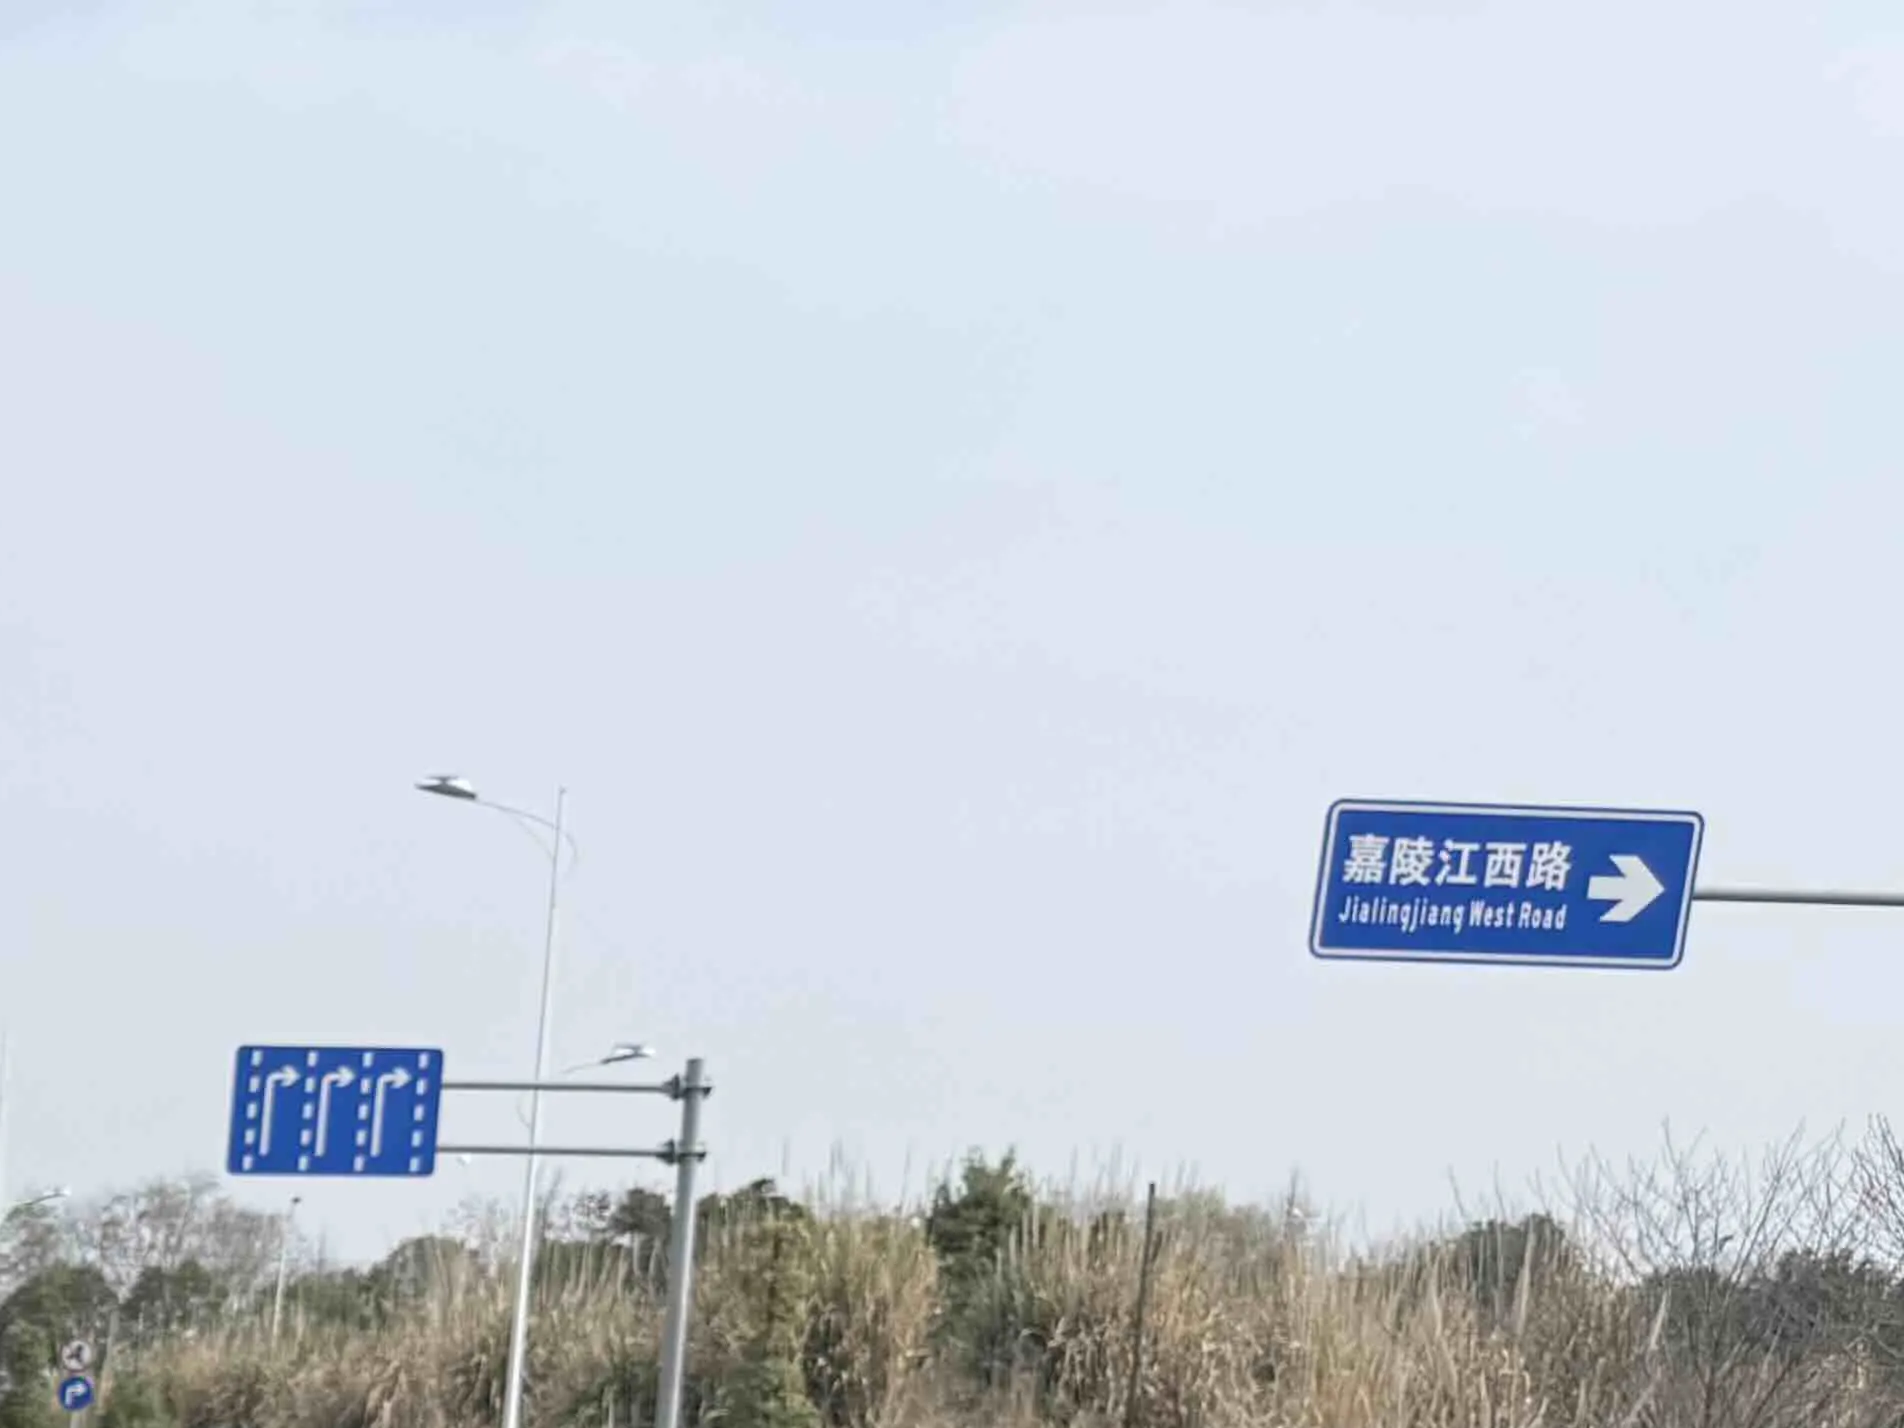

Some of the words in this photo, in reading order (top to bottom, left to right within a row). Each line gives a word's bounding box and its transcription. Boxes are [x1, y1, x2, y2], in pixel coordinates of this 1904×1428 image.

[1342, 832, 1573, 891] 嘉陵江西路
[1339, 895, 1465, 934] Jialingjiang
[1469, 899, 1514, 928] West
[1517, 901, 1567, 930] Road
